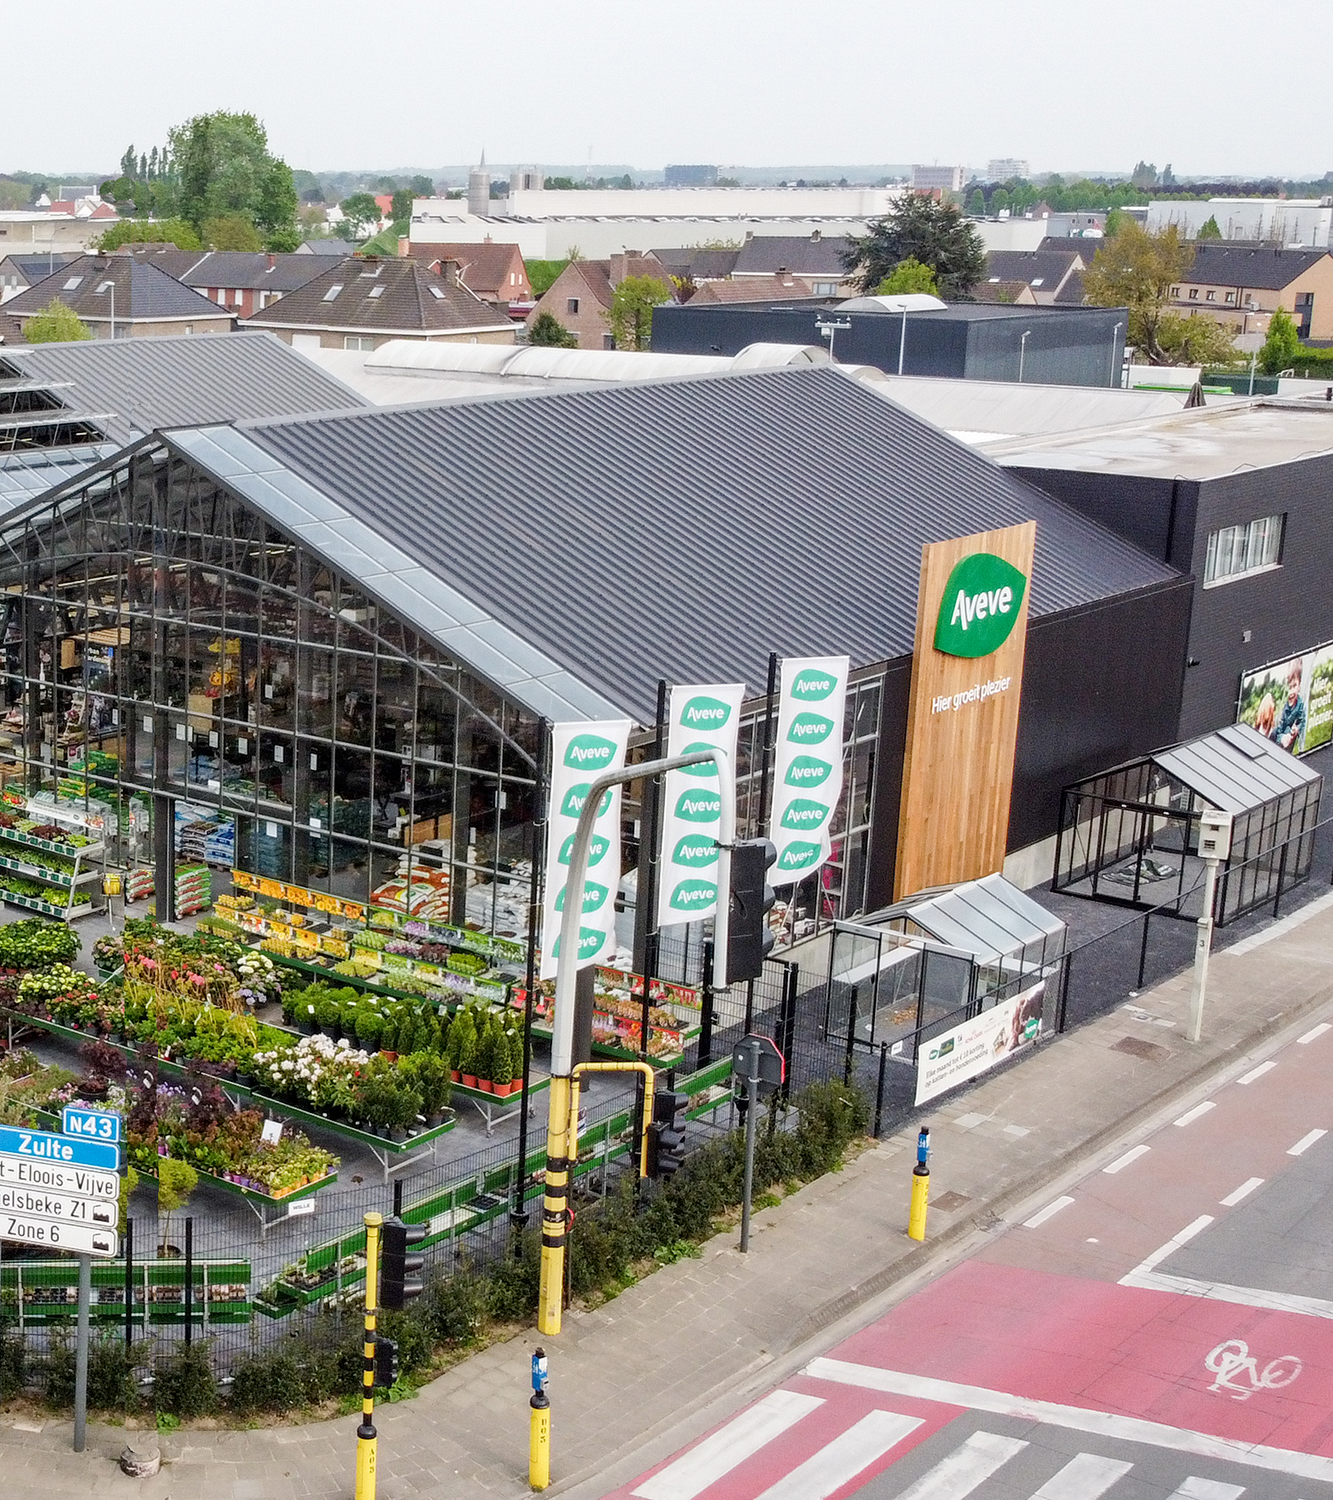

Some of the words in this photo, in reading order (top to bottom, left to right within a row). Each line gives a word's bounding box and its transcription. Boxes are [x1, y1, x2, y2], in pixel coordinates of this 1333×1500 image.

[951, 586, 1013, 630] Aveve
[796, 679, 830, 693] Aveve
[932, 695, 952, 714] Hier
[953, 684, 980, 711] groeit
[980, 676, 1011, 701] plezier
[687, 706, 724, 721] Aveve
[793, 722, 827, 736] Aveve
[571, 746, 610, 761] Aveve
[791, 766, 824, 779] Aveve
[682, 799, 720, 814] Aveve
[787, 809, 823, 823] Aveve
[677, 888, 714, 903] Aveve
[1199, 940, 1205, 948] 3
[70, 1116, 112, 1138] N43
[18, 1134, 74, 1160] Zulte
[71, 1200, 86, 1219] Z1
[8, 1218, 45, 1240] Zone
[50, 1225, 60, 1242] 6
